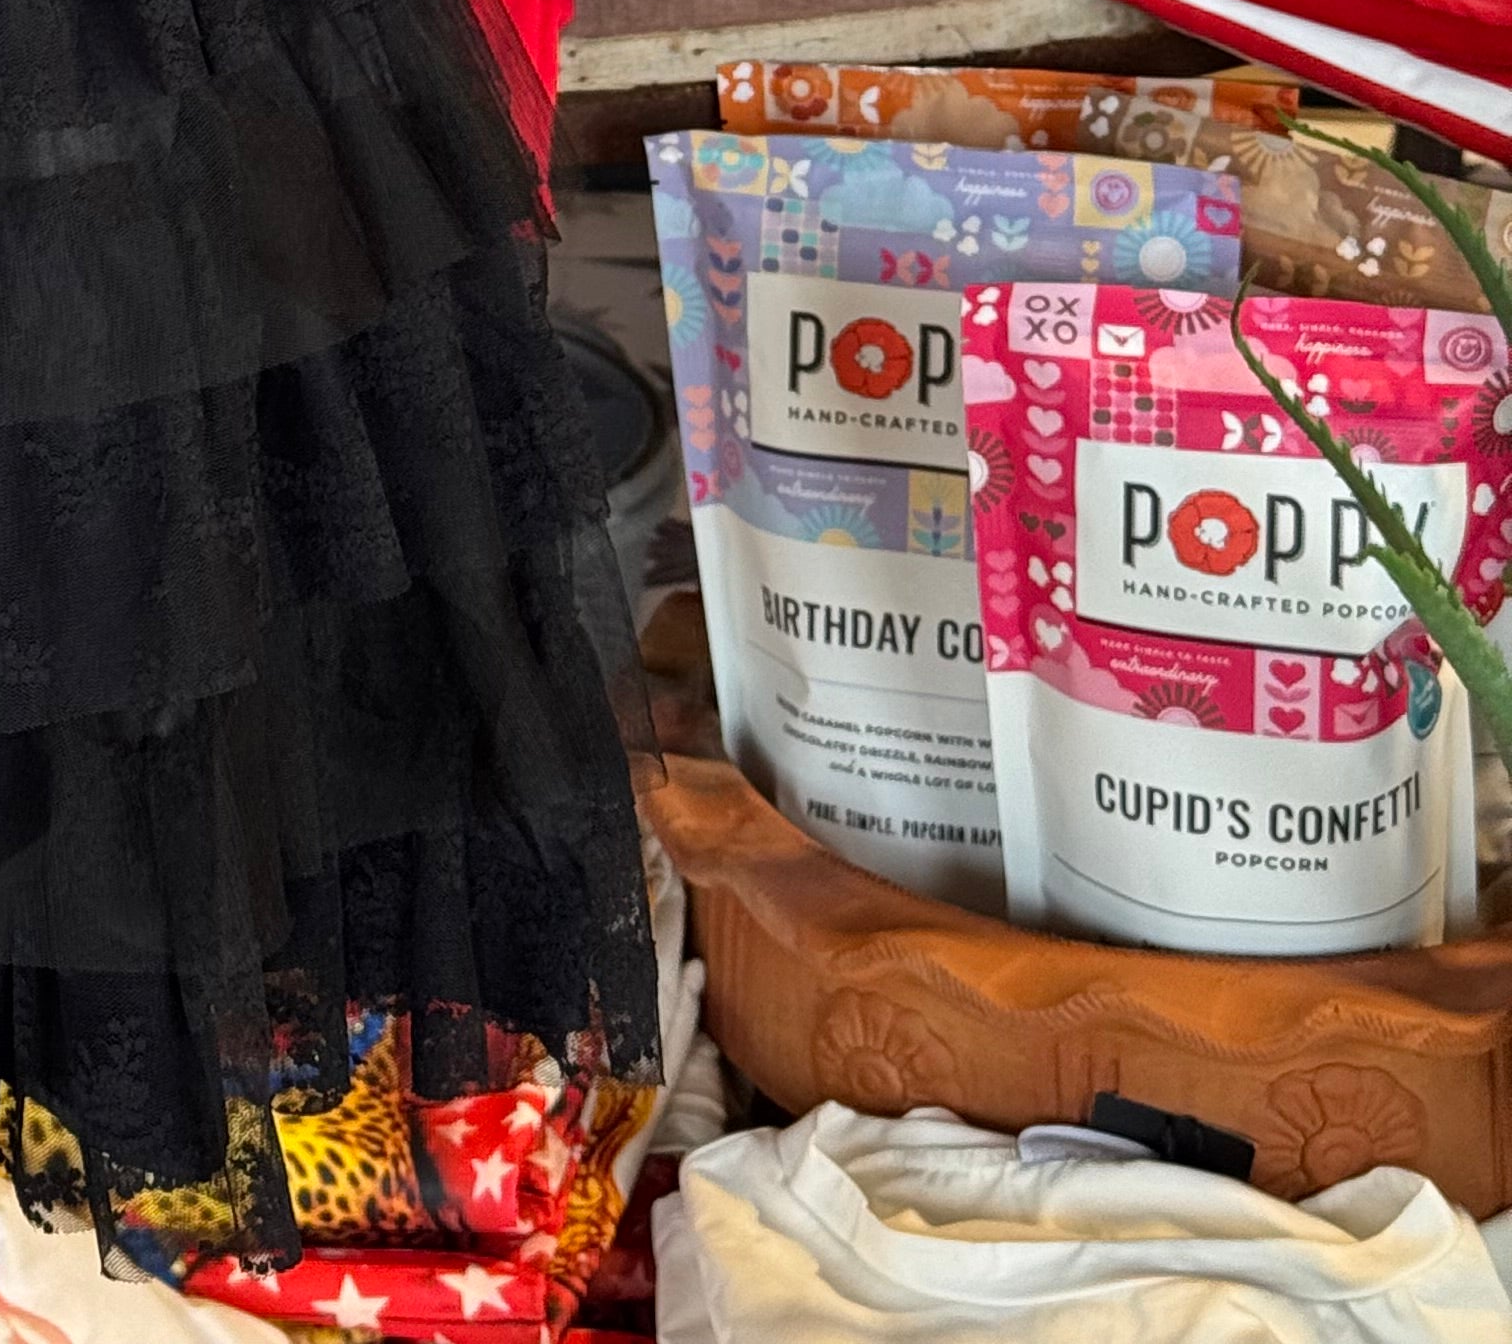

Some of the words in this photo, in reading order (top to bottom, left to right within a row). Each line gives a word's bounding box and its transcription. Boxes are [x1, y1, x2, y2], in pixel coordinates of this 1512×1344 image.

[1024, 294, 1081, 318] OX
[1023, 315, 1079, 345] XO
[788, 405, 960, 437] HAND-CRAFTED
[1121, 579, 1311, 615] HAND-CRAFTED
[1321, 601, 1415, 621] POPCOR
[761, 584, 922, 656] BIRTHDAY
[937, 618, 985, 664] CO
[1094, 771, 1251, 841] CUPID'S
[1268, 770, 1422, 846] CONFETTI
[1214, 850, 1328, 872] POPCORN
